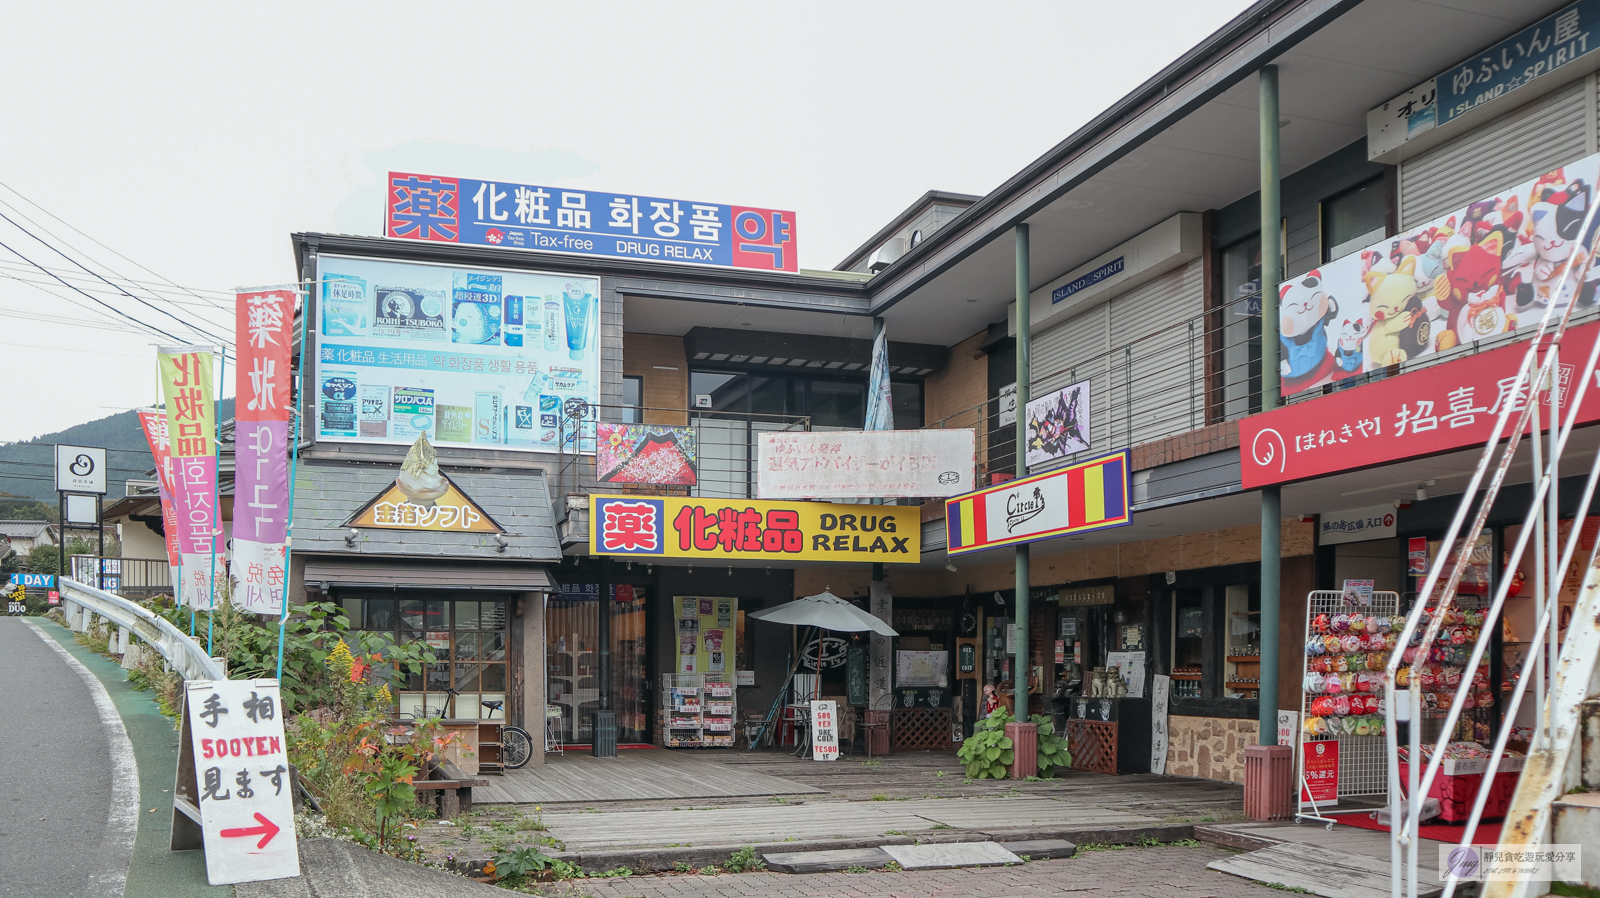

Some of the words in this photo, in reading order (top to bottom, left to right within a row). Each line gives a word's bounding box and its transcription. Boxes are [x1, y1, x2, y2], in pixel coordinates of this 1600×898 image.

[1452, 7, 1581, 95] ゆふいん屋
[1449, 83, 1505, 119] ISLAND
[1523, 31, 1590, 83] SPIRIT
[391, 174, 458, 240] 薬
[472, 181, 592, 229] 化粧品
[607, 196, 723, 242] 화장품
[532, 231, 594, 250] Tax-free
[616, 240, 660, 257] DRUG
[664, 244, 713, 261] RELAX
[735, 209, 790, 269] 약
[1053, 278, 1086, 302] ISLAND
[1093, 259, 1124, 282] SPIRIT
[321, 347, 335, 361] 薬
[336, 349, 375, 364] 化粧品
[377, 352, 428, 367] 生活用品
[448, 356, 484, 372] 화장품
[487, 358, 512, 373] 생활
[514, 360, 539, 375] 용품
[373, 501, 480, 528] 金箔ソフト
[603, 500, 658, 551] 薬
[819, 512, 897, 533] DRUG
[1364, 517, 1382, 529] 入口
[673, 504, 804, 553] 化粧品
[811, 533, 910, 554] RELAX
[24, 575, 51, 586] DAY
[8, 590, 26, 599] LATTE
[8, 604, 26, 613] DUO
[199, 691, 275, 728] 手相
[814, 745, 837, 753] TESOU
[201, 764, 286, 802] 見ます
